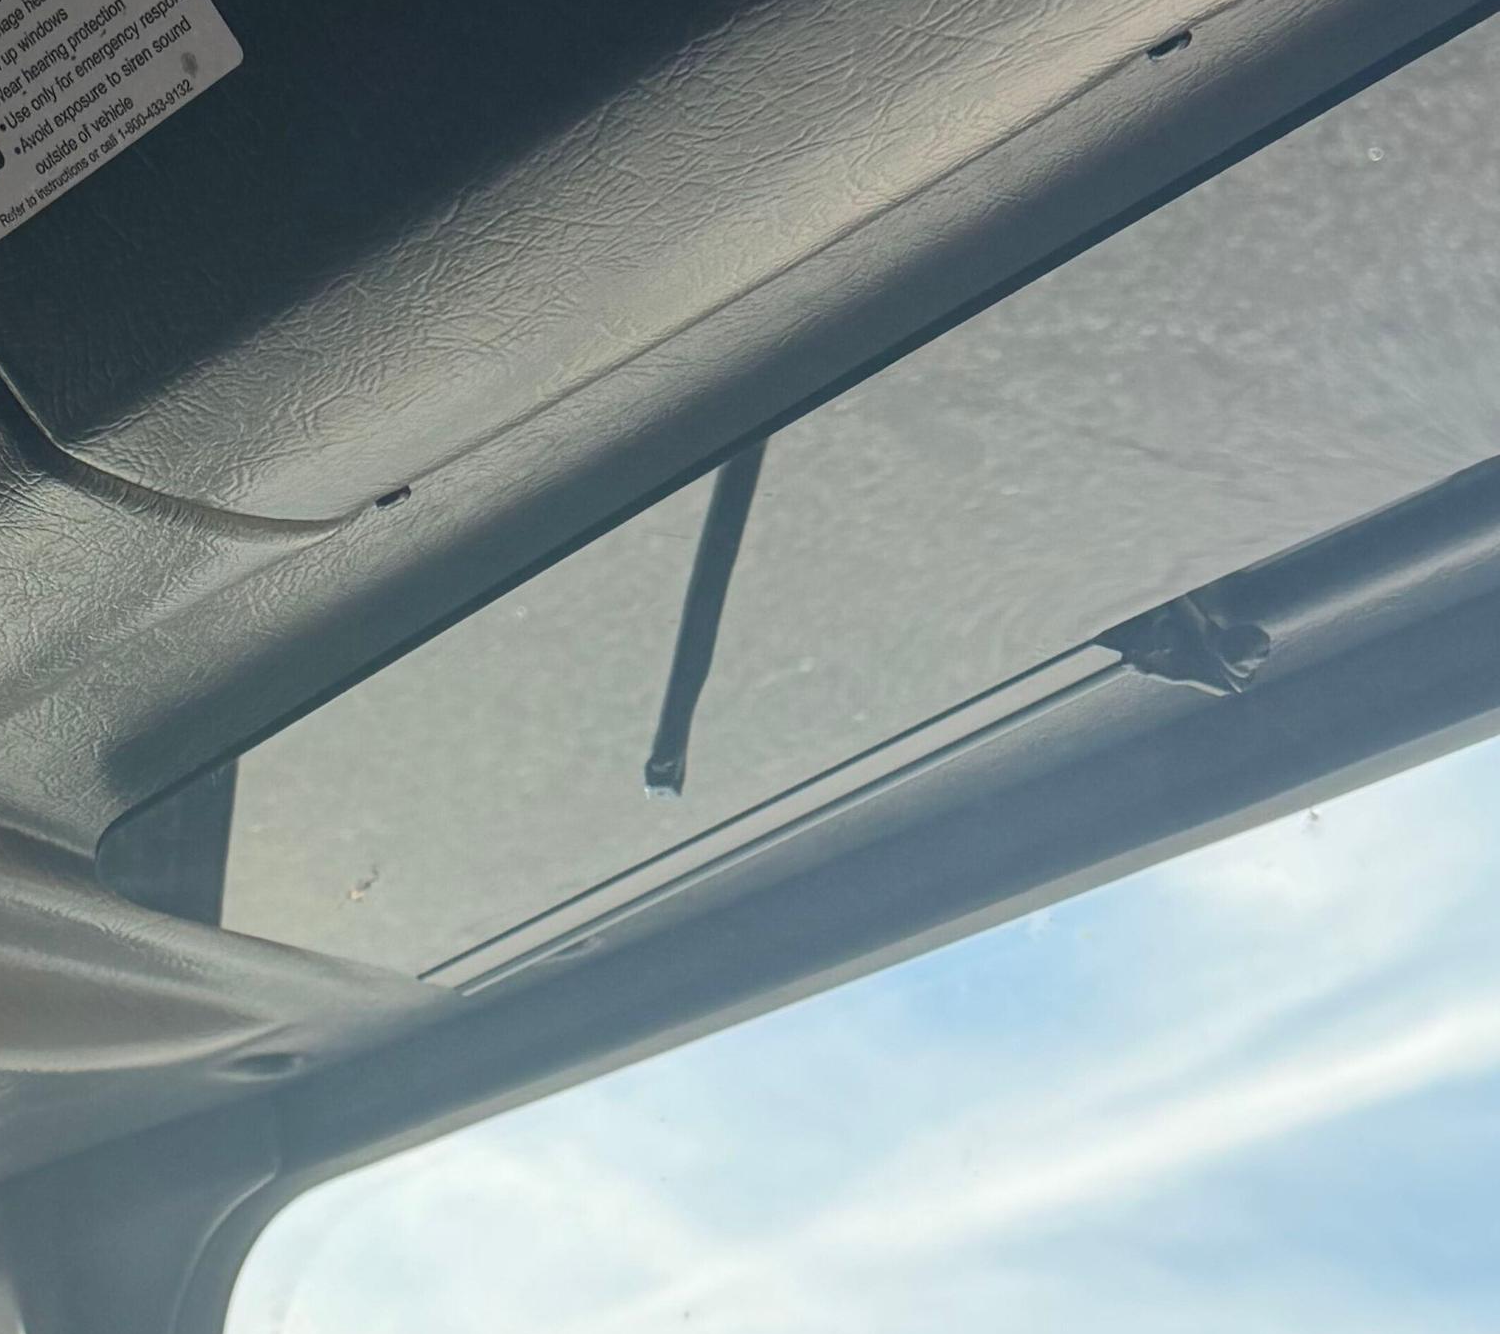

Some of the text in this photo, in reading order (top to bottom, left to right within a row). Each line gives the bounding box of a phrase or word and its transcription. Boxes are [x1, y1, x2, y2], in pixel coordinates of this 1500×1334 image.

[0, 47, 17, 65] up
[17, 8, 68, 51] windows
[3, 106, 31, 128] Use
[30, 85, 57, 110] only
[54, 71, 74, 91] for
[74, 21, 139, 77] emergency
[20, 43, 69, 83] hearing
[19, 14, 191, 153] Avoid exposure to siren sound
[24, 195, 37, 208] to
[35, 157, 89, 199] instructions
[88, 148, 99, 162] or
[99, 133, 118, 153] call
[117, 78, 193, 139] 1-800-433-9132
[35, 97, 133, 174] outside of vehicle
